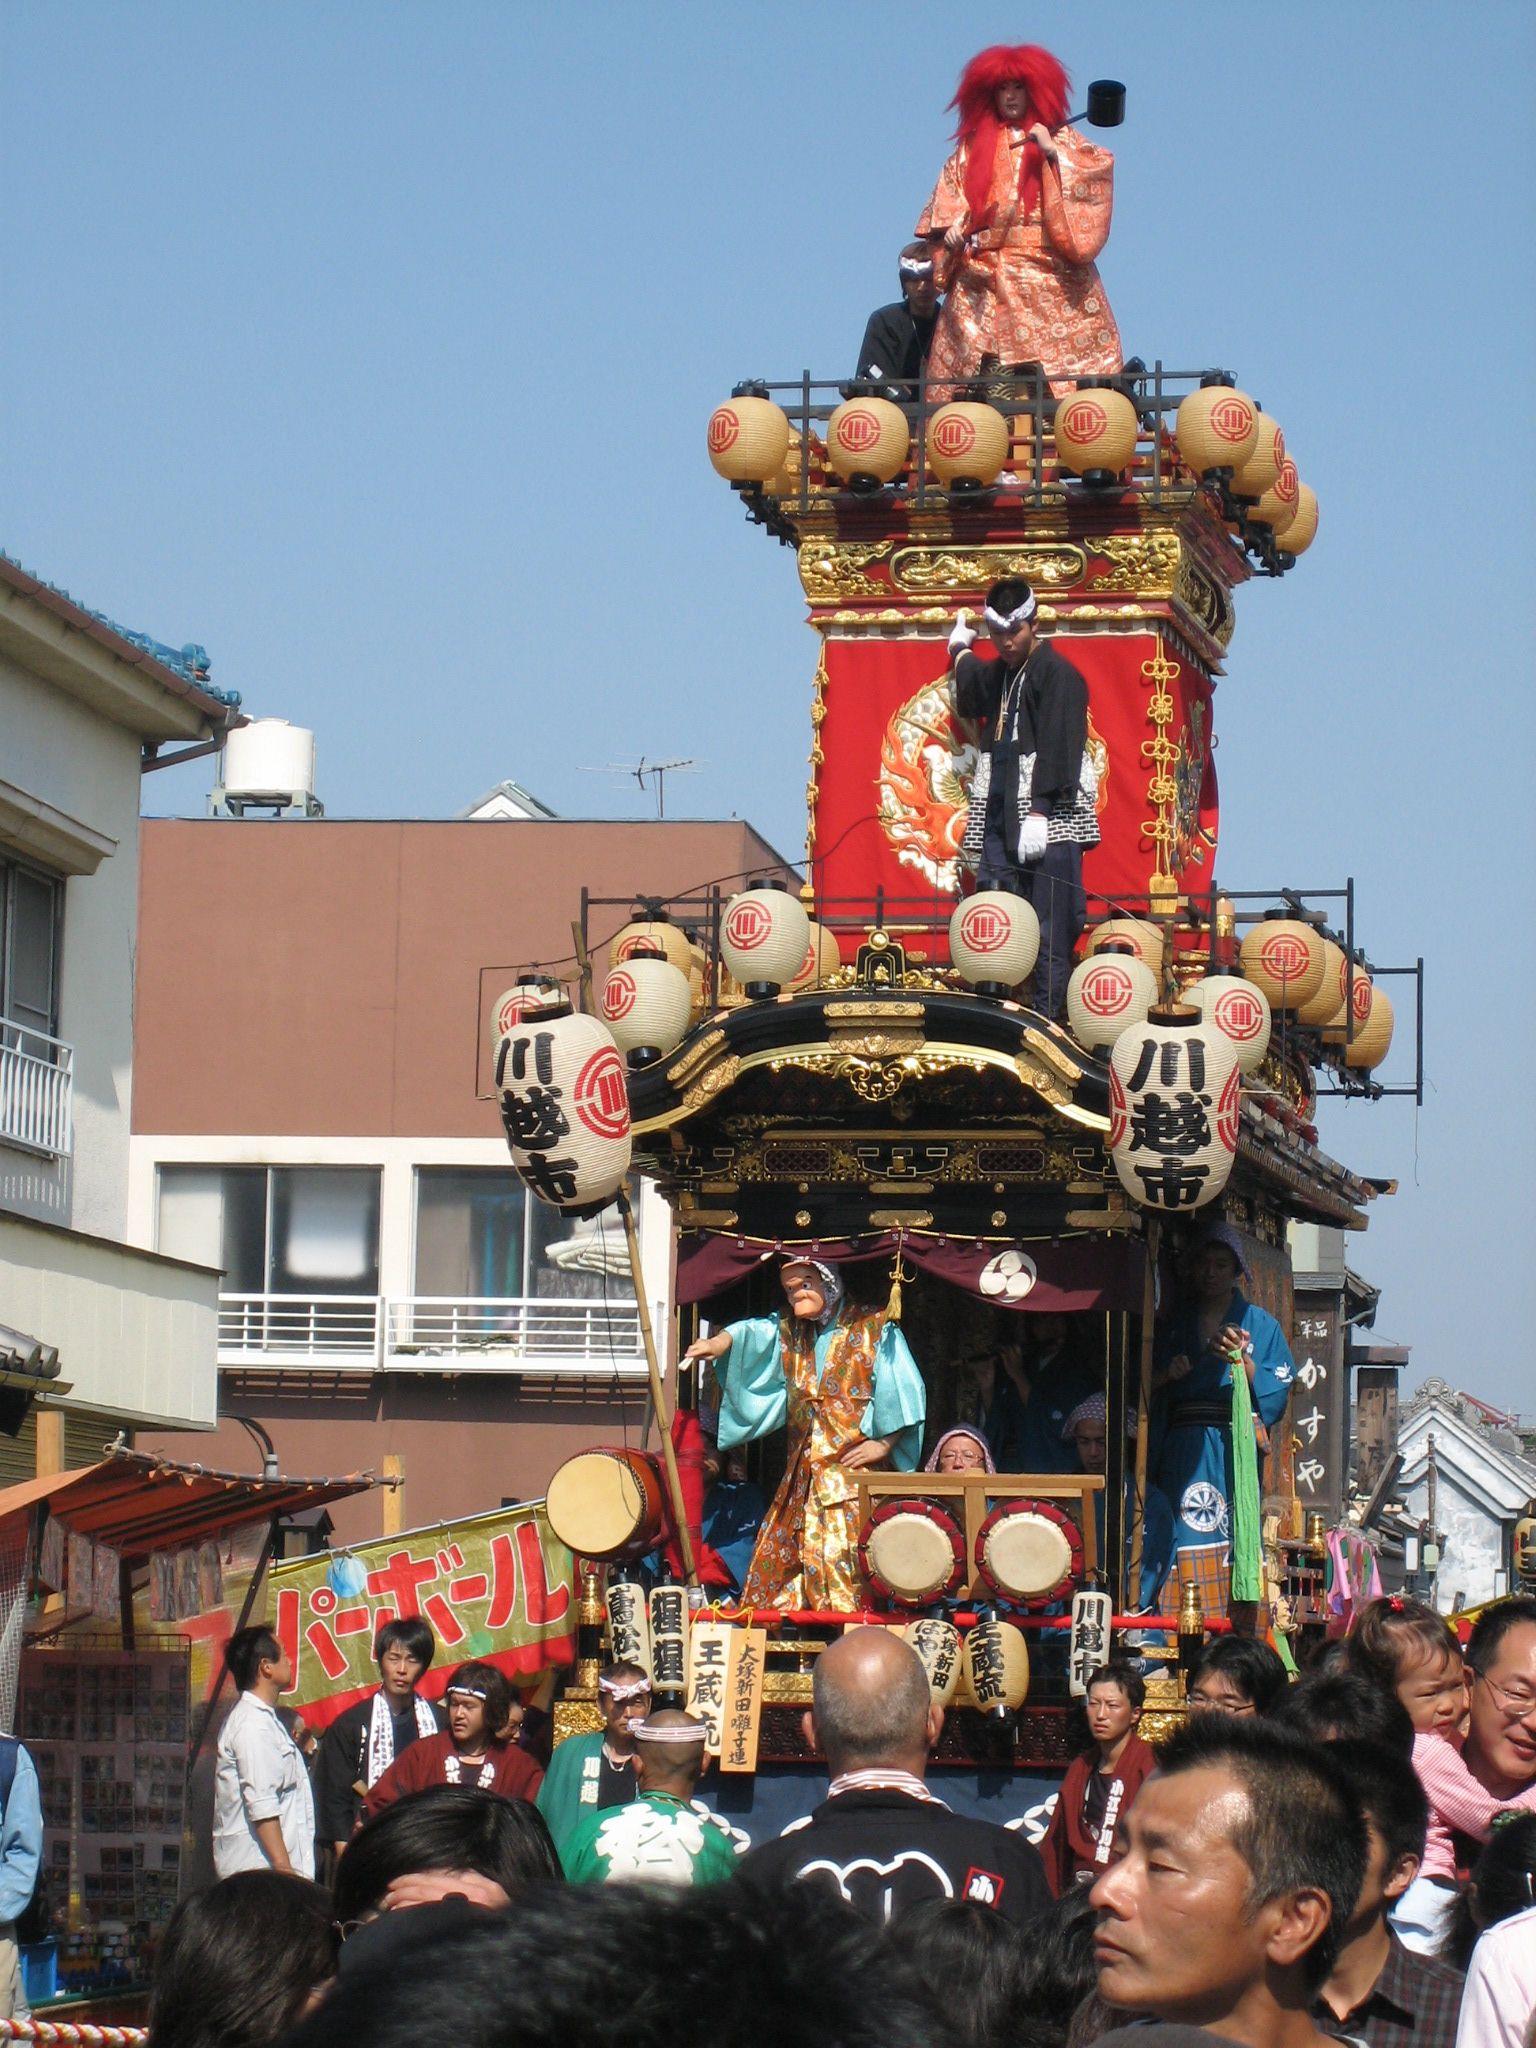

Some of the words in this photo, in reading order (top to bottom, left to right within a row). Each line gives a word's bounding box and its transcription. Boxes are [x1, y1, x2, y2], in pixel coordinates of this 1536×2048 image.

[496, 1032, 578, 1203] 川越市
[1126, 1038, 1212, 1208] 川越市
[1297, 1357, 1328, 1493] かすや
[912, 1620, 941, 1669] はや
[932, 1625, 959, 1690] 大塚新田
[1074, 1598, 1105, 1686] 川越市
[580, 1757, 600, 1804] 川越
[1095, 1779, 1125, 1864] 小江戸川越
